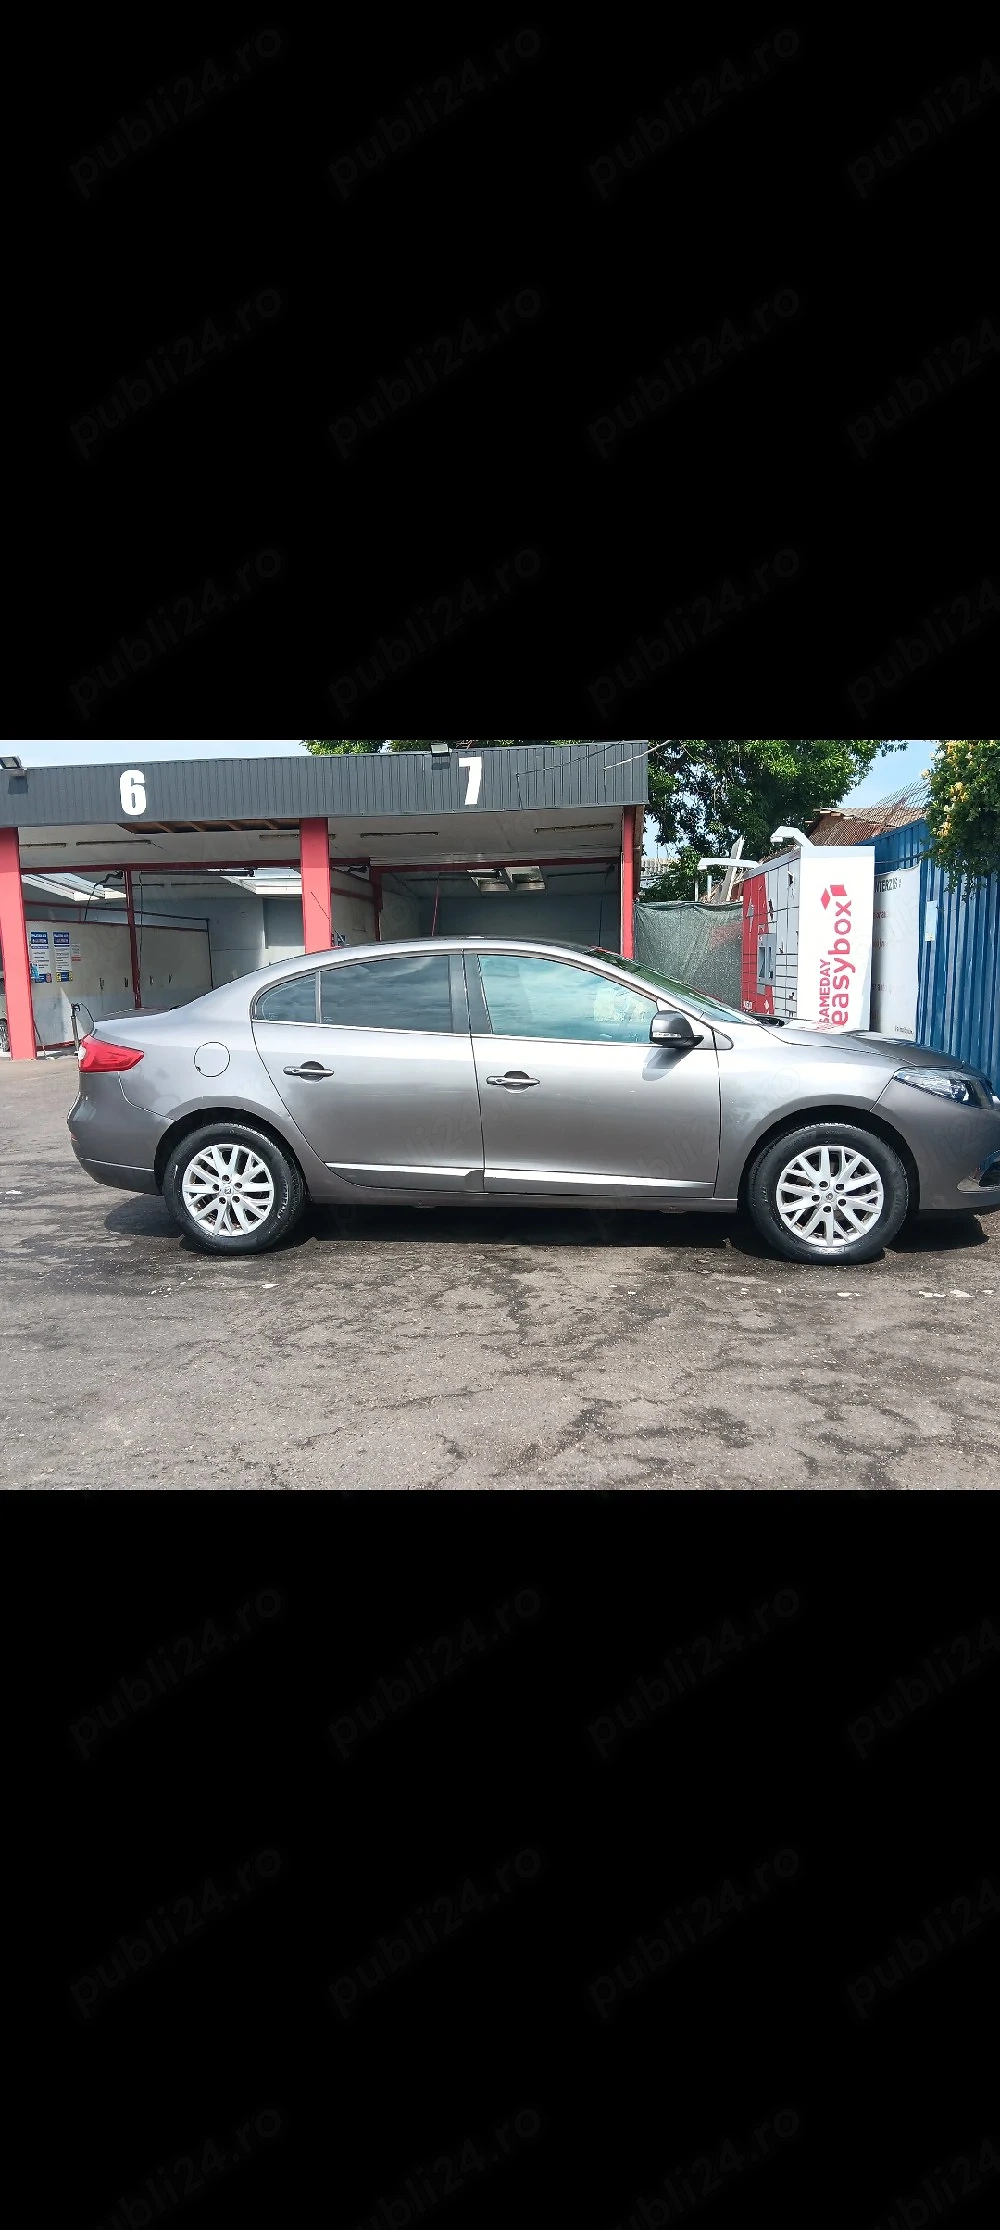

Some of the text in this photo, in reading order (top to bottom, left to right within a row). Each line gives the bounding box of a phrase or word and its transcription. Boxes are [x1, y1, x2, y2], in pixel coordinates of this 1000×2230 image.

[119, 769, 147, 816] 6
[458, 756, 483, 806] 7
[818, 958, 831, 1024] SAMEDAY
[828, 900, 856, 1026] easybox
